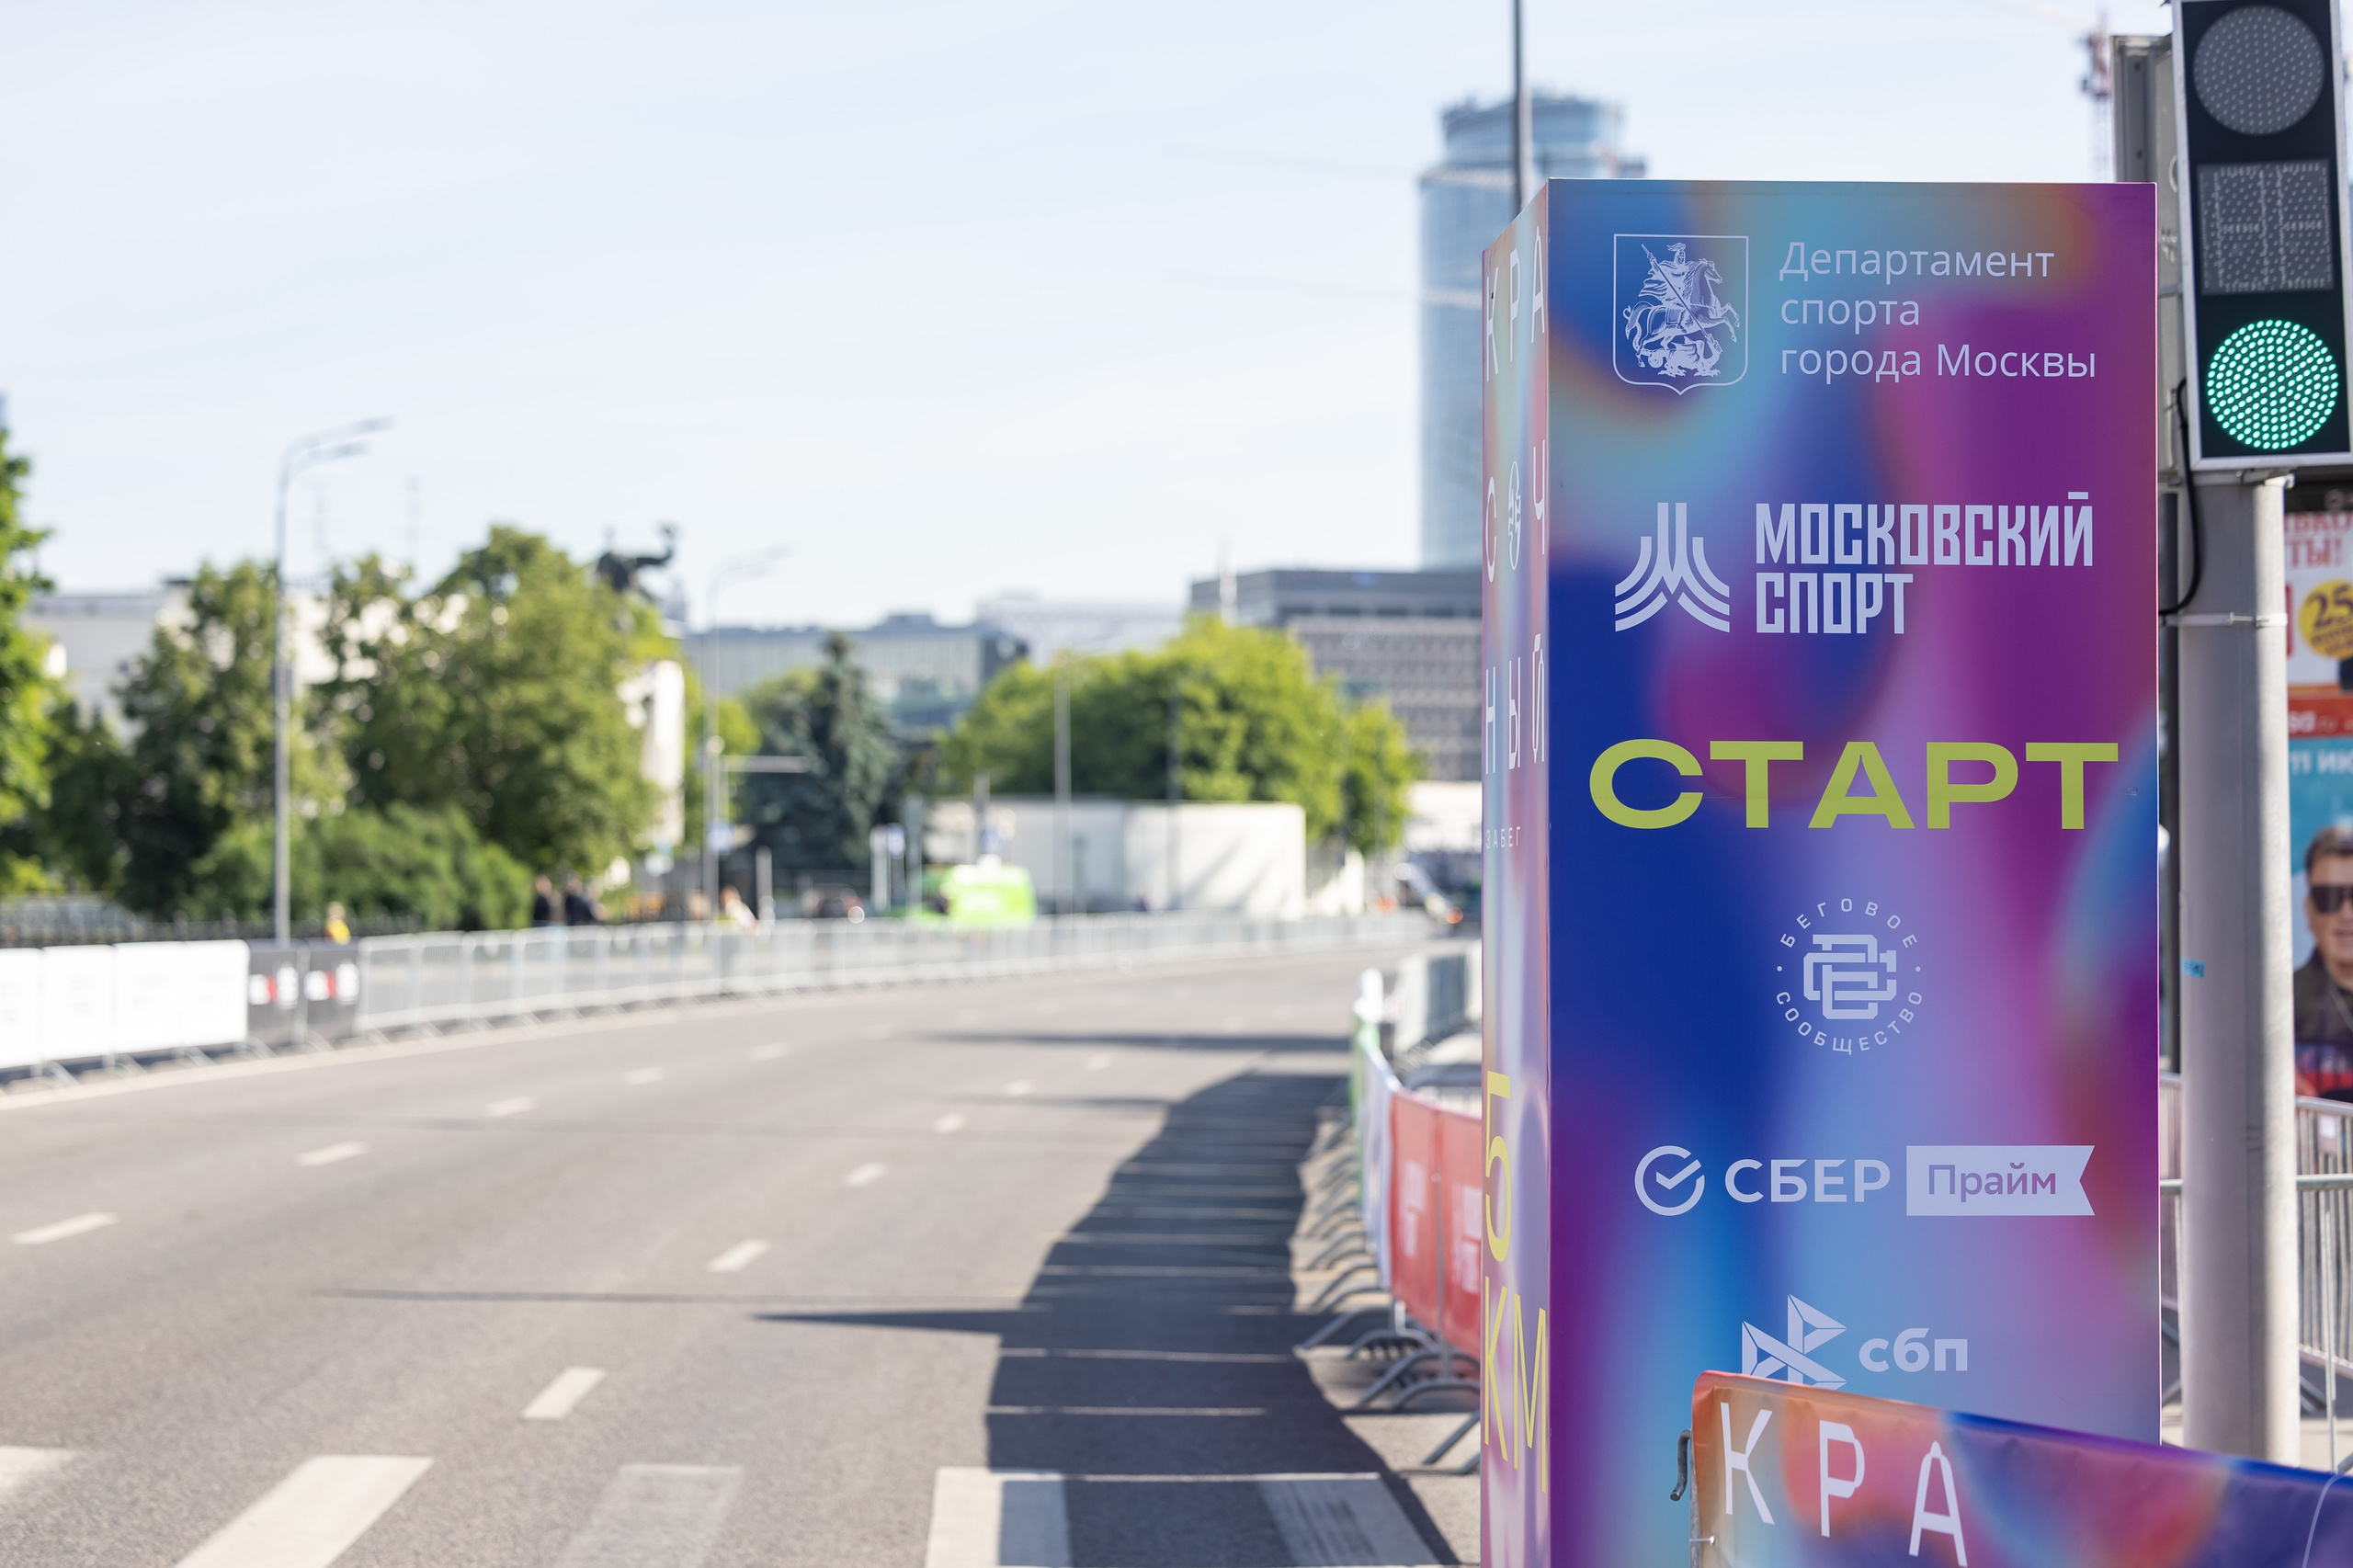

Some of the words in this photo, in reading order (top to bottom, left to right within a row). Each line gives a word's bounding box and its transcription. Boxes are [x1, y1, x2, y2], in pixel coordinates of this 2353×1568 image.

[1779, 242, 2055, 282] Департамент
[1780, 298, 1920, 334] спорта
[1780, 350, 1922, 384] города
[1937, 344, 2096, 378] Москвы
[1756, 491, 2094, 567] МОСКОВСКИЙ
[1756, 573, 1914, 634] СПОРТ
[1589, 739, 2120, 830] СТАРТ
[1485, 824, 1522, 849] ЗАБЕГ
[1779, 898, 1918, 949] БЕГОВОЕ
[1776, 991, 1923, 1056] СООБЩЕСТВО
[1484, 1071, 1512, 1263] 5
[1725, 1158, 1891, 1203] СБЕР
[1927, 1163, 2057, 1203] Прайм
[1859, 1327, 1969, 1372] сбп
[1483, 1275, 1548, 1494] КМ
[1720, 1402, 1969, 1568] КРА
